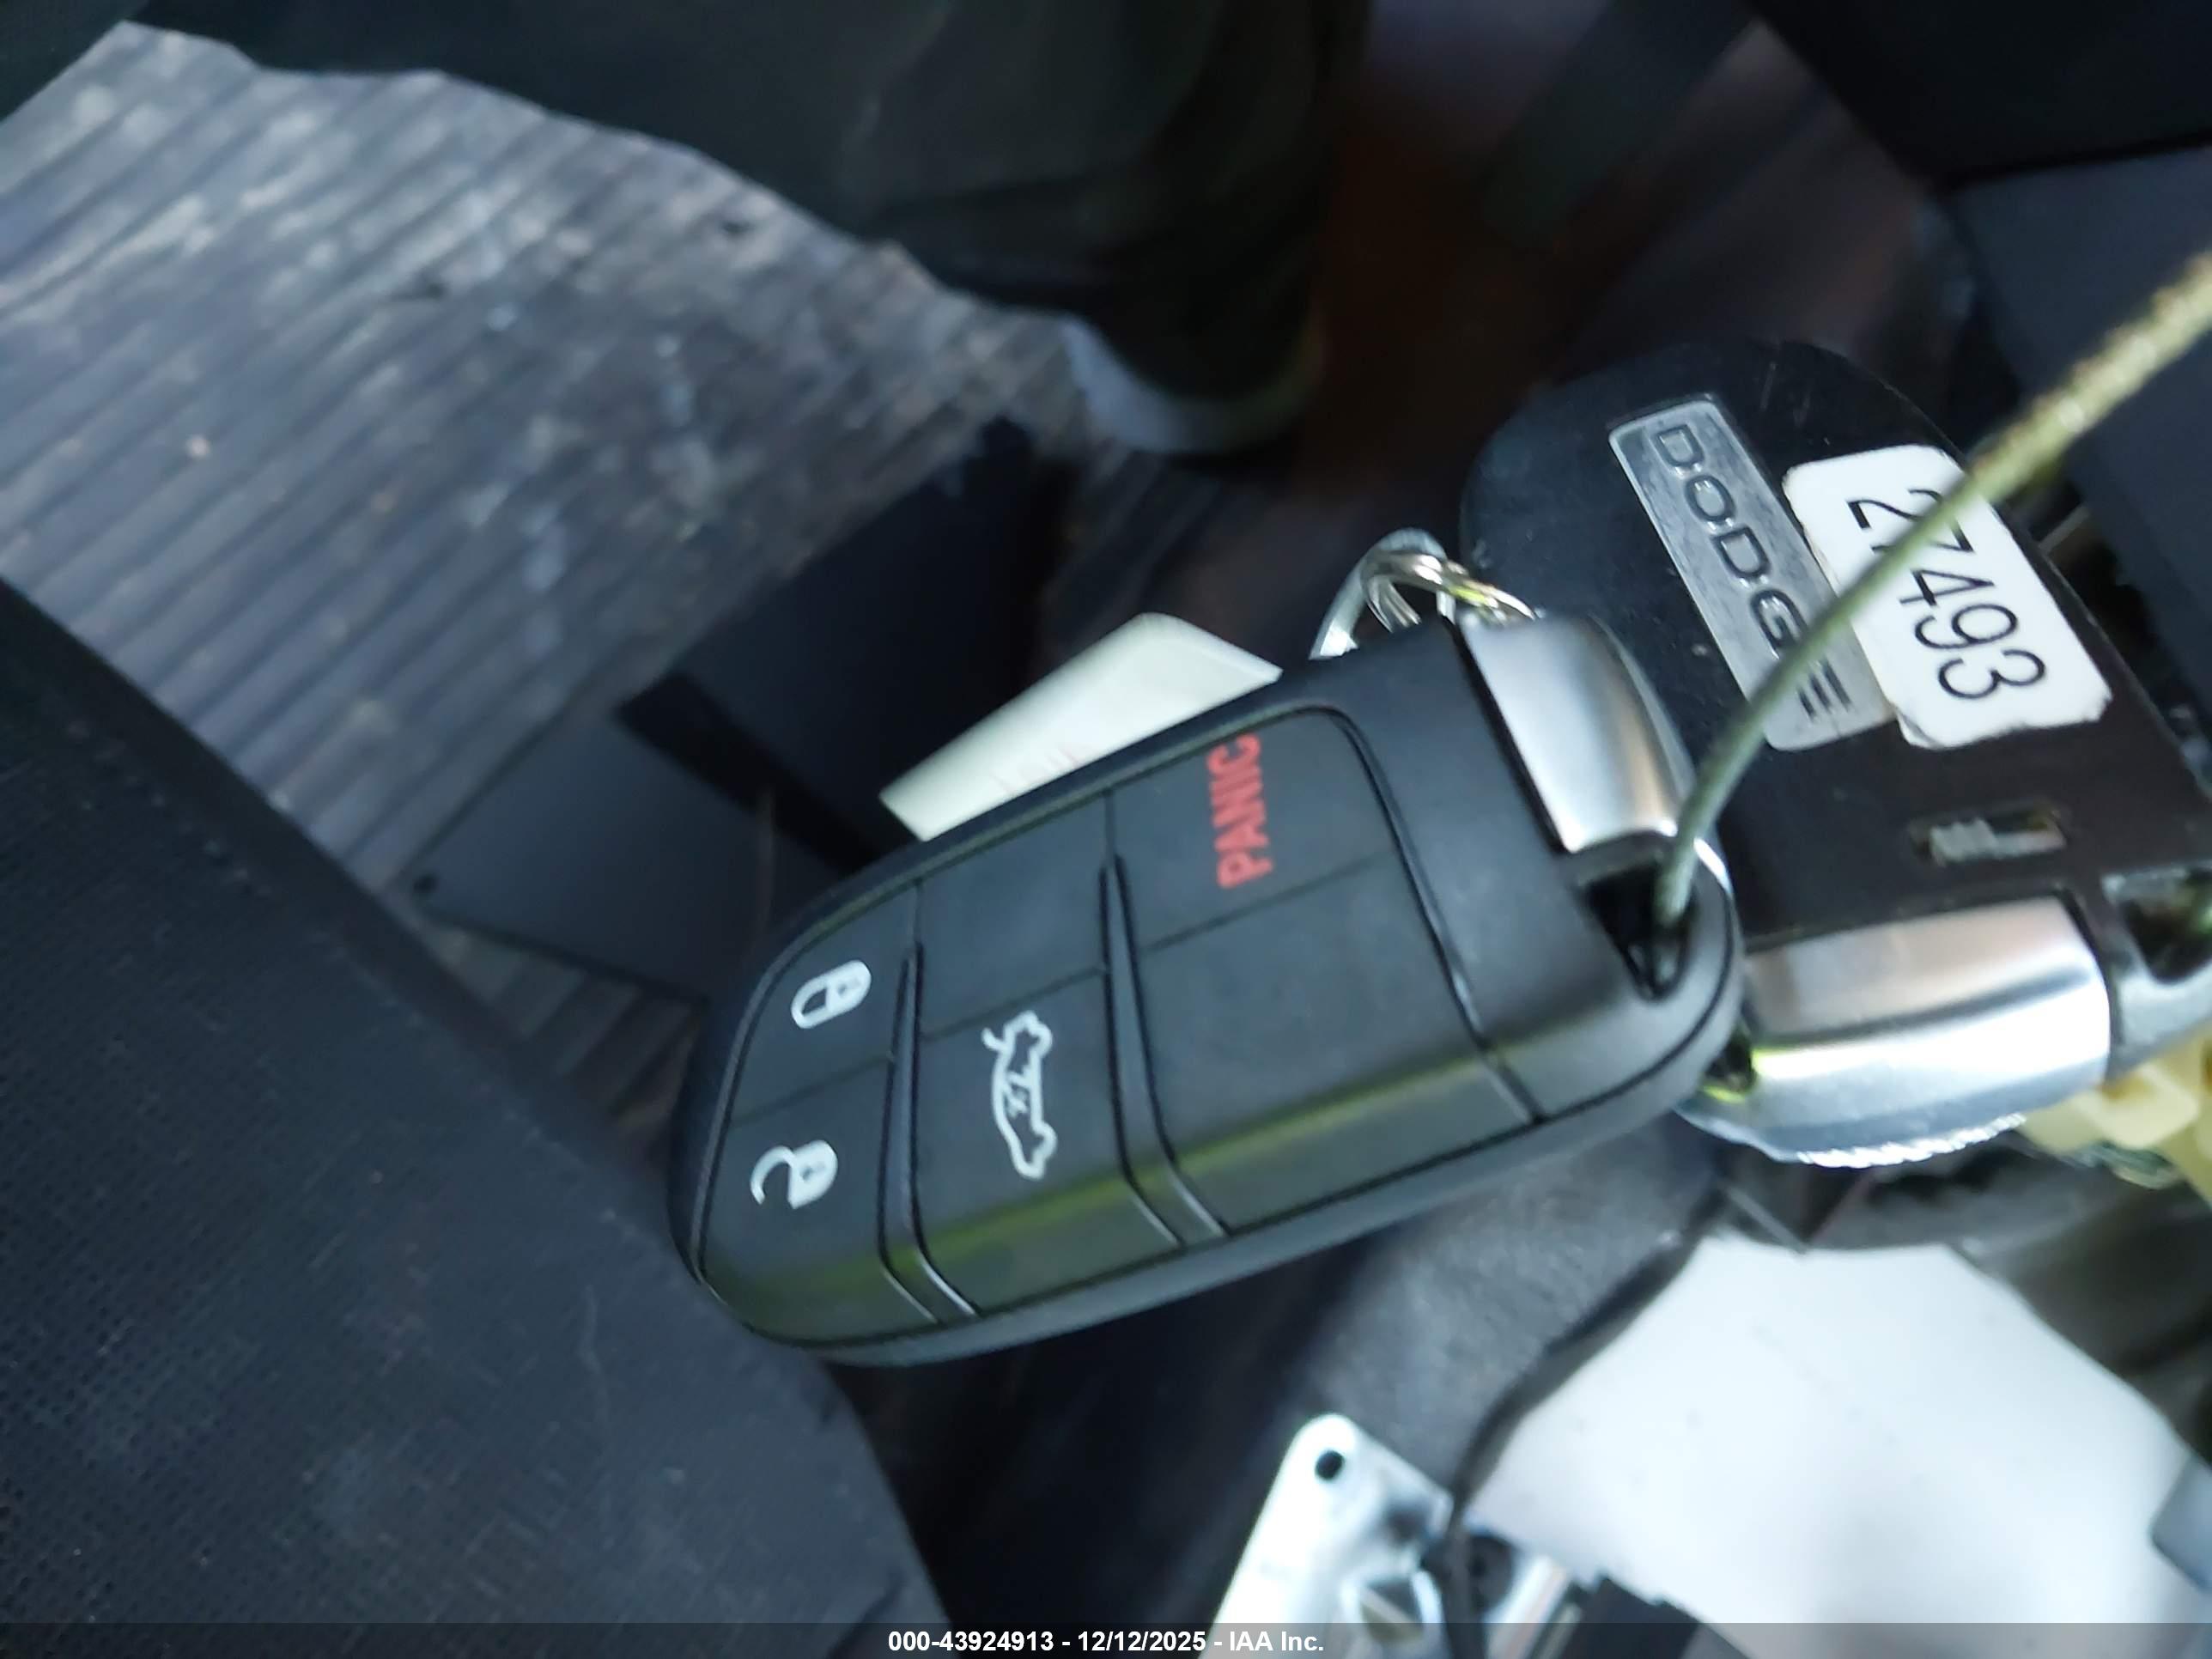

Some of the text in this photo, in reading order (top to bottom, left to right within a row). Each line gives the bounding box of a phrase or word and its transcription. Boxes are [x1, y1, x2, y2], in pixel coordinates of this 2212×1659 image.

[1649, 425, 1852, 719] DODGE
[1846, 488, 2045, 700] 27493
[1207, 734, 1273, 888] PANIC
